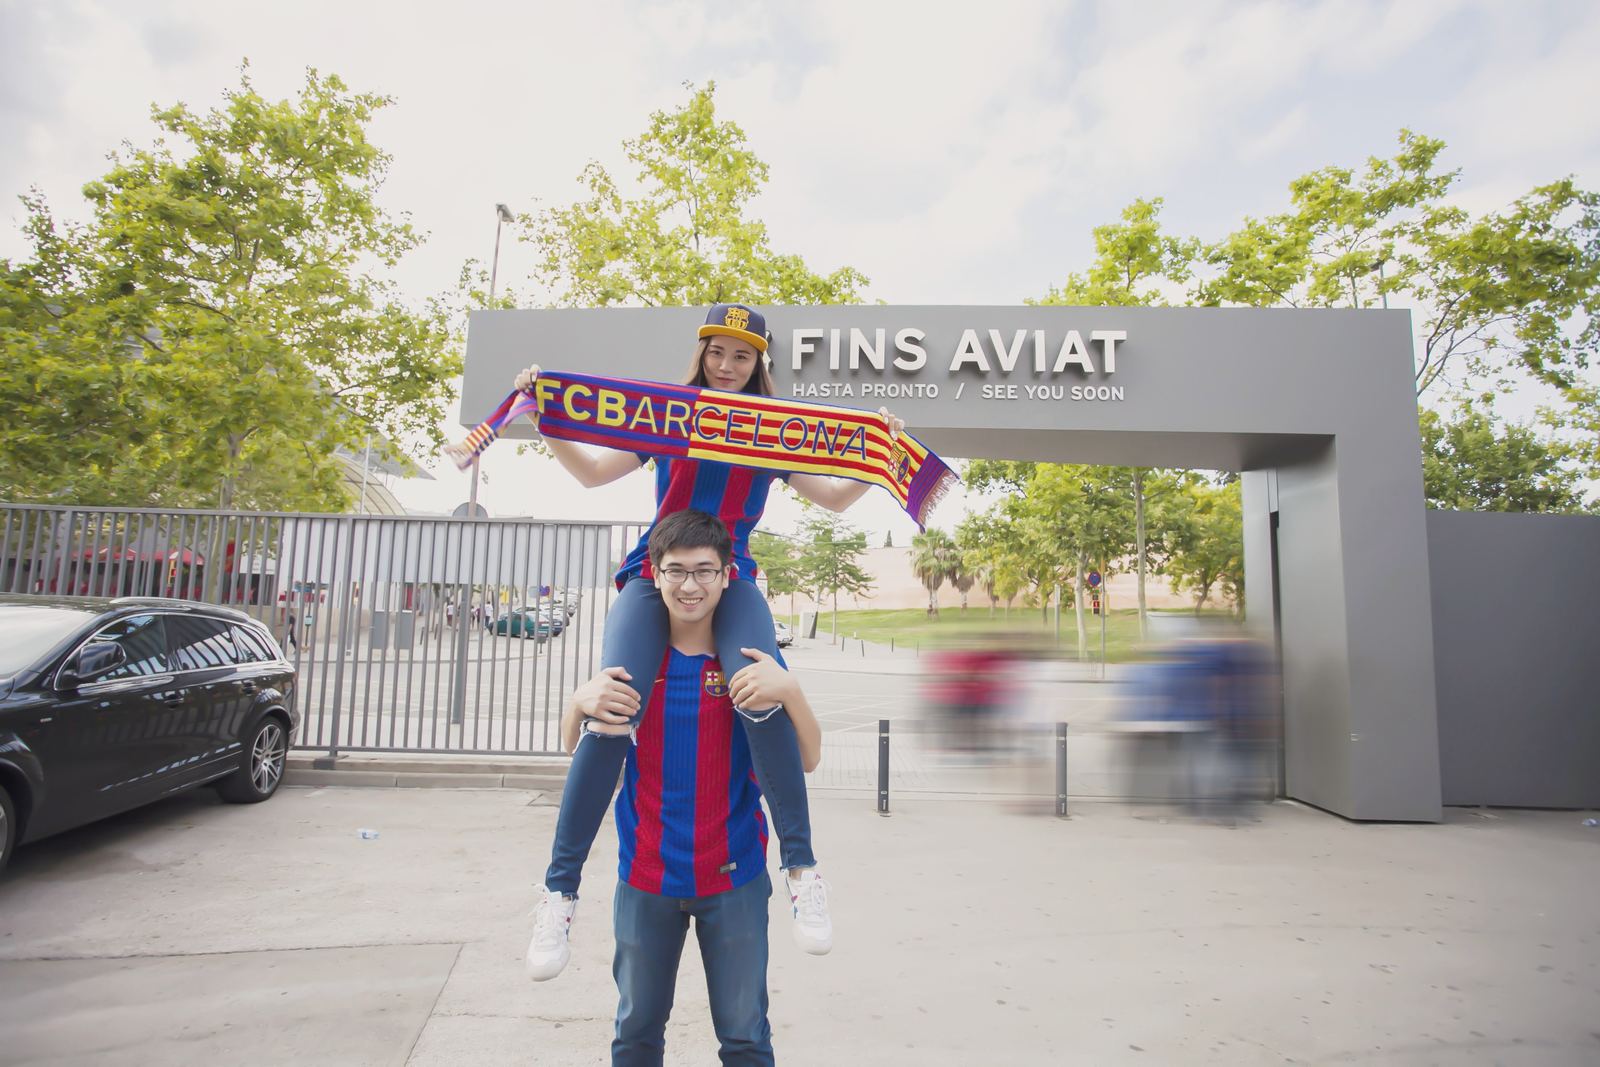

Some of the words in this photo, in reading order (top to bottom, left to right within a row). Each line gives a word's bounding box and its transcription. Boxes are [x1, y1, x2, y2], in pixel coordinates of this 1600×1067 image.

[791, 327, 928, 372] FINS
[948, 328, 1128, 374] AVIAT
[792, 383, 854, 397] HASTA
[861, 383, 939, 398] PRONTO
[982, 384, 1018, 399] SEE
[1024, 385, 1064, 400] YOU
[1071, 385, 1125, 401] SOON
